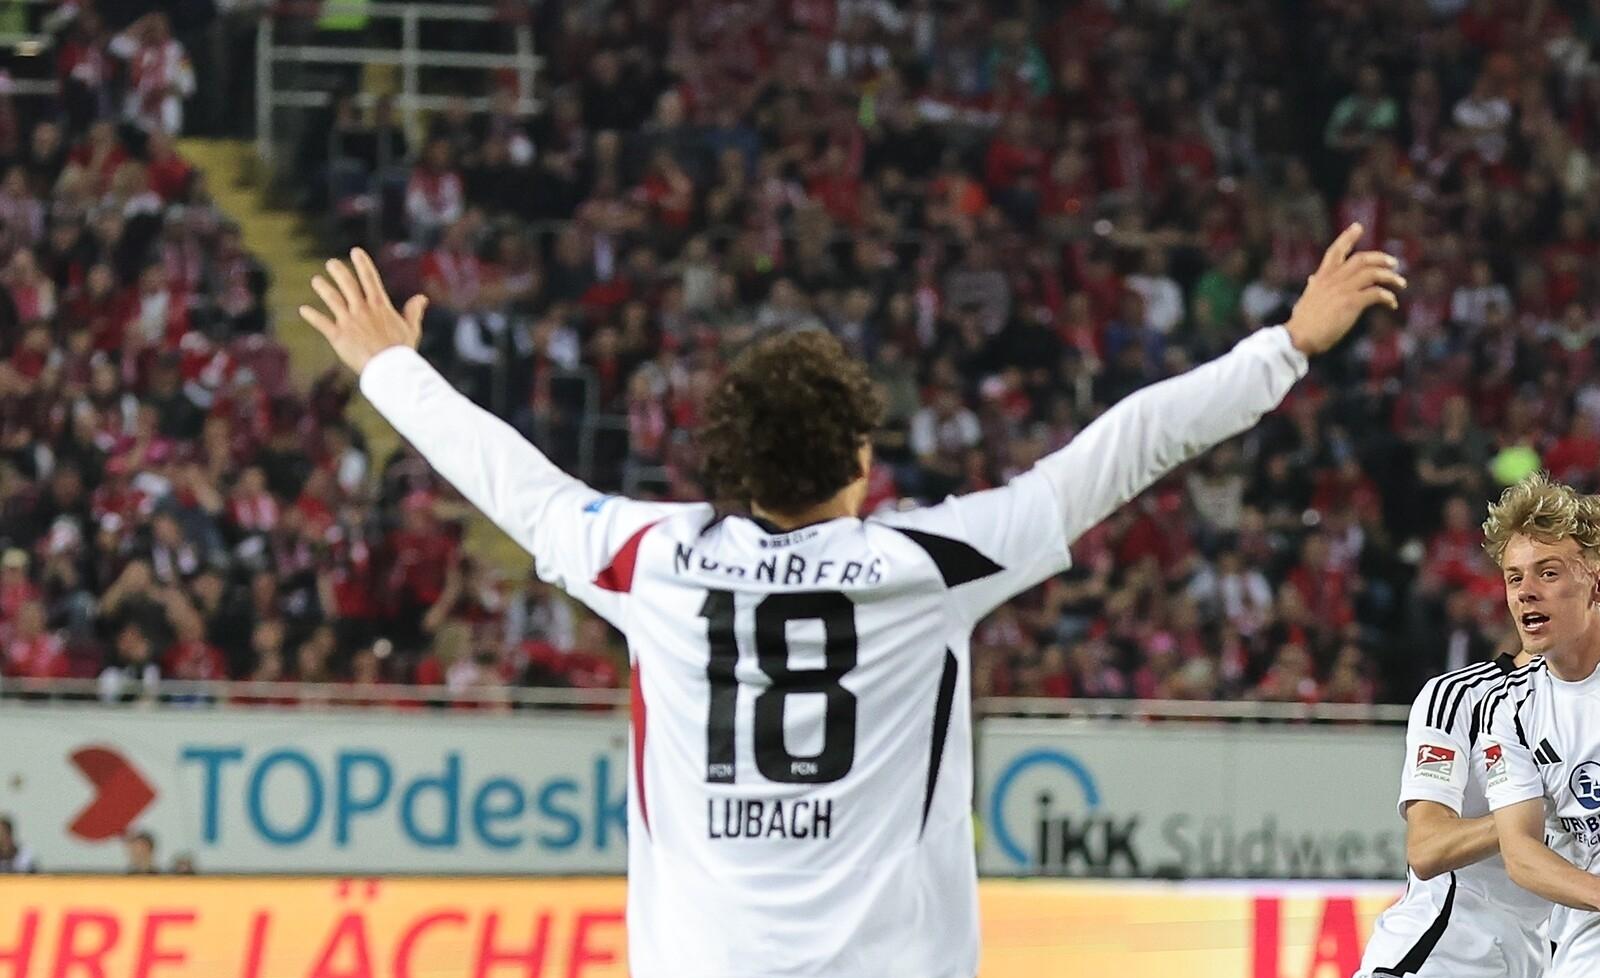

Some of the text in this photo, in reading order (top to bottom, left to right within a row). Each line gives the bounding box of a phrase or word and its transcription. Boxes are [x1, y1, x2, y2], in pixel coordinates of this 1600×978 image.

[698, 588, 858, 784] 18
[181, 745, 628, 850] TOPdesk
[708, 798, 832, 839] LUBACH
